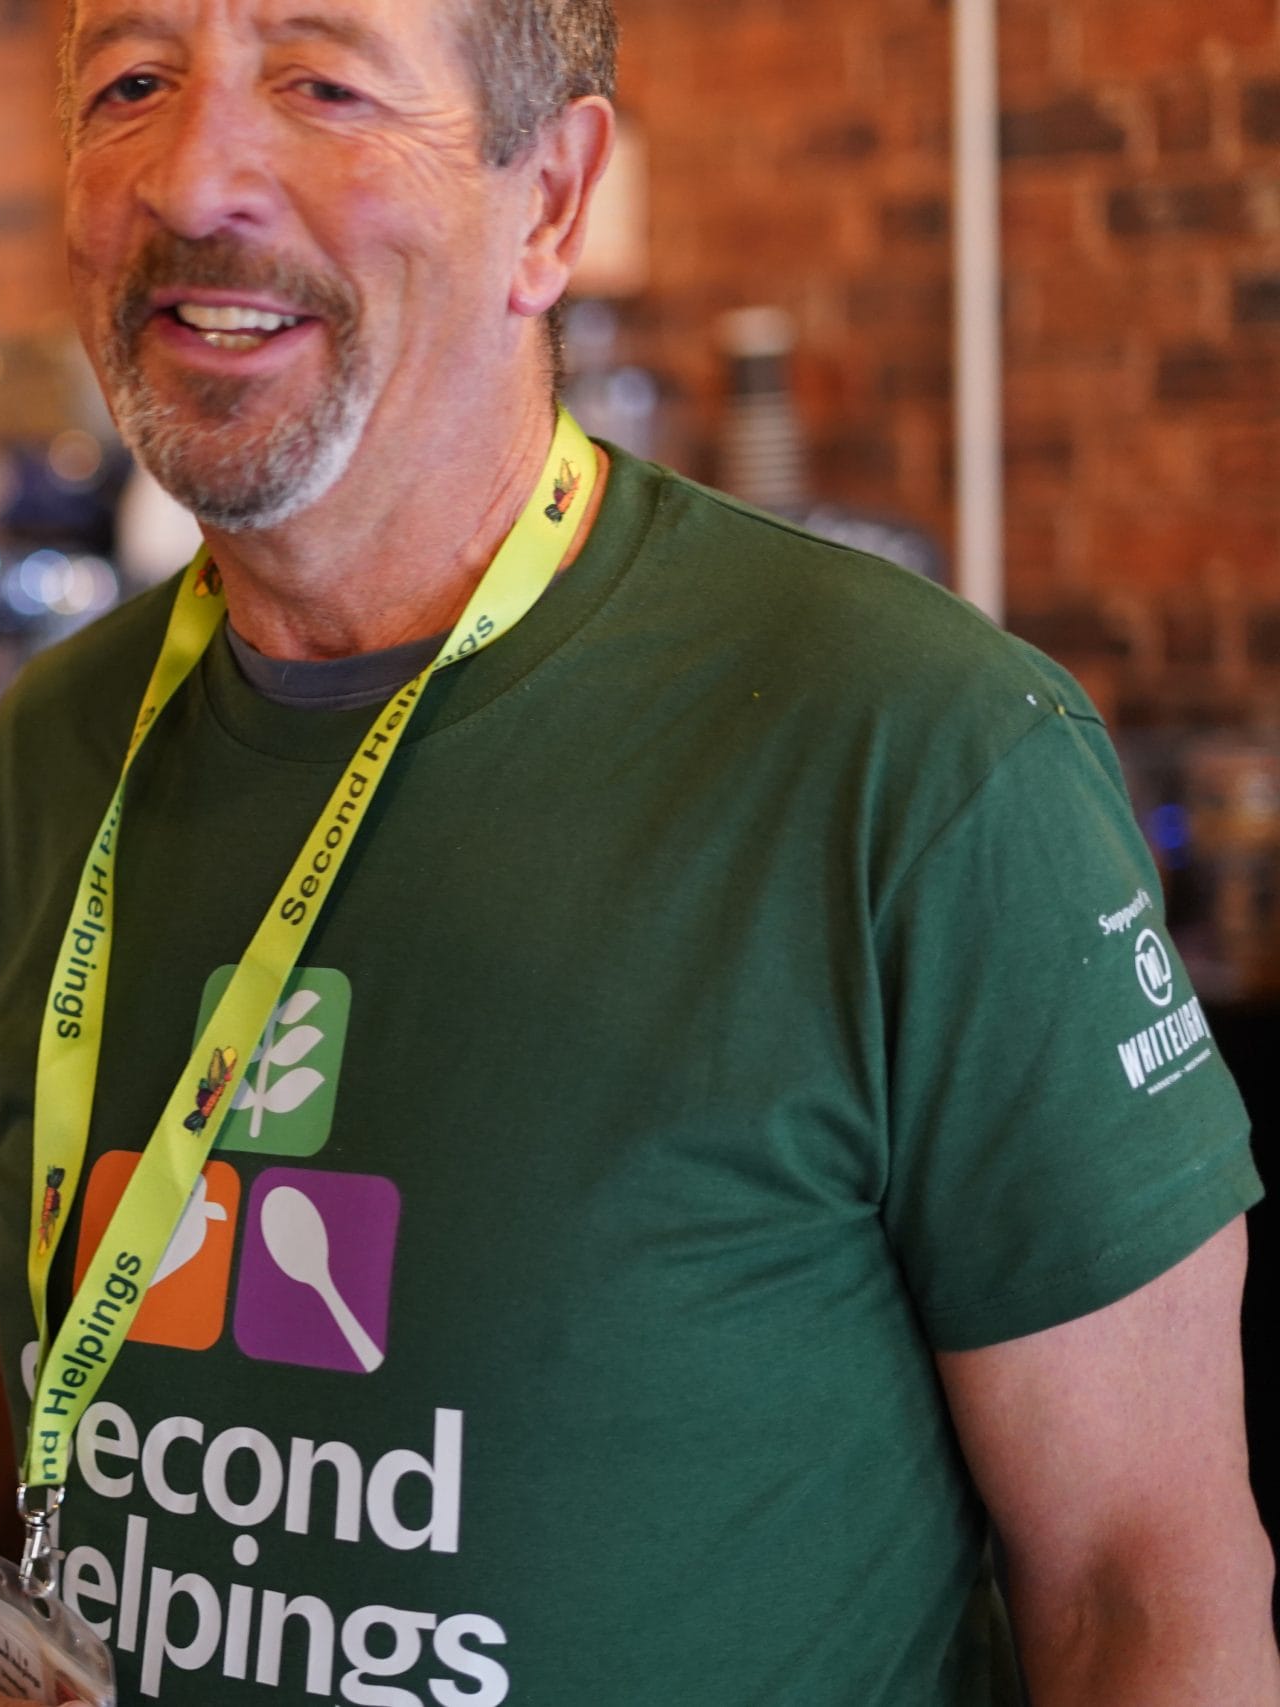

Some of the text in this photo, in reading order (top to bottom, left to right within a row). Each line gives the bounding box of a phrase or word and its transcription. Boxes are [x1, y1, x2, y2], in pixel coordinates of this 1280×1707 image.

[280, 772, 368, 926] Second
[53, 864, 108, 1039] Helpings
[42, 1251, 141, 1415] Helpings
